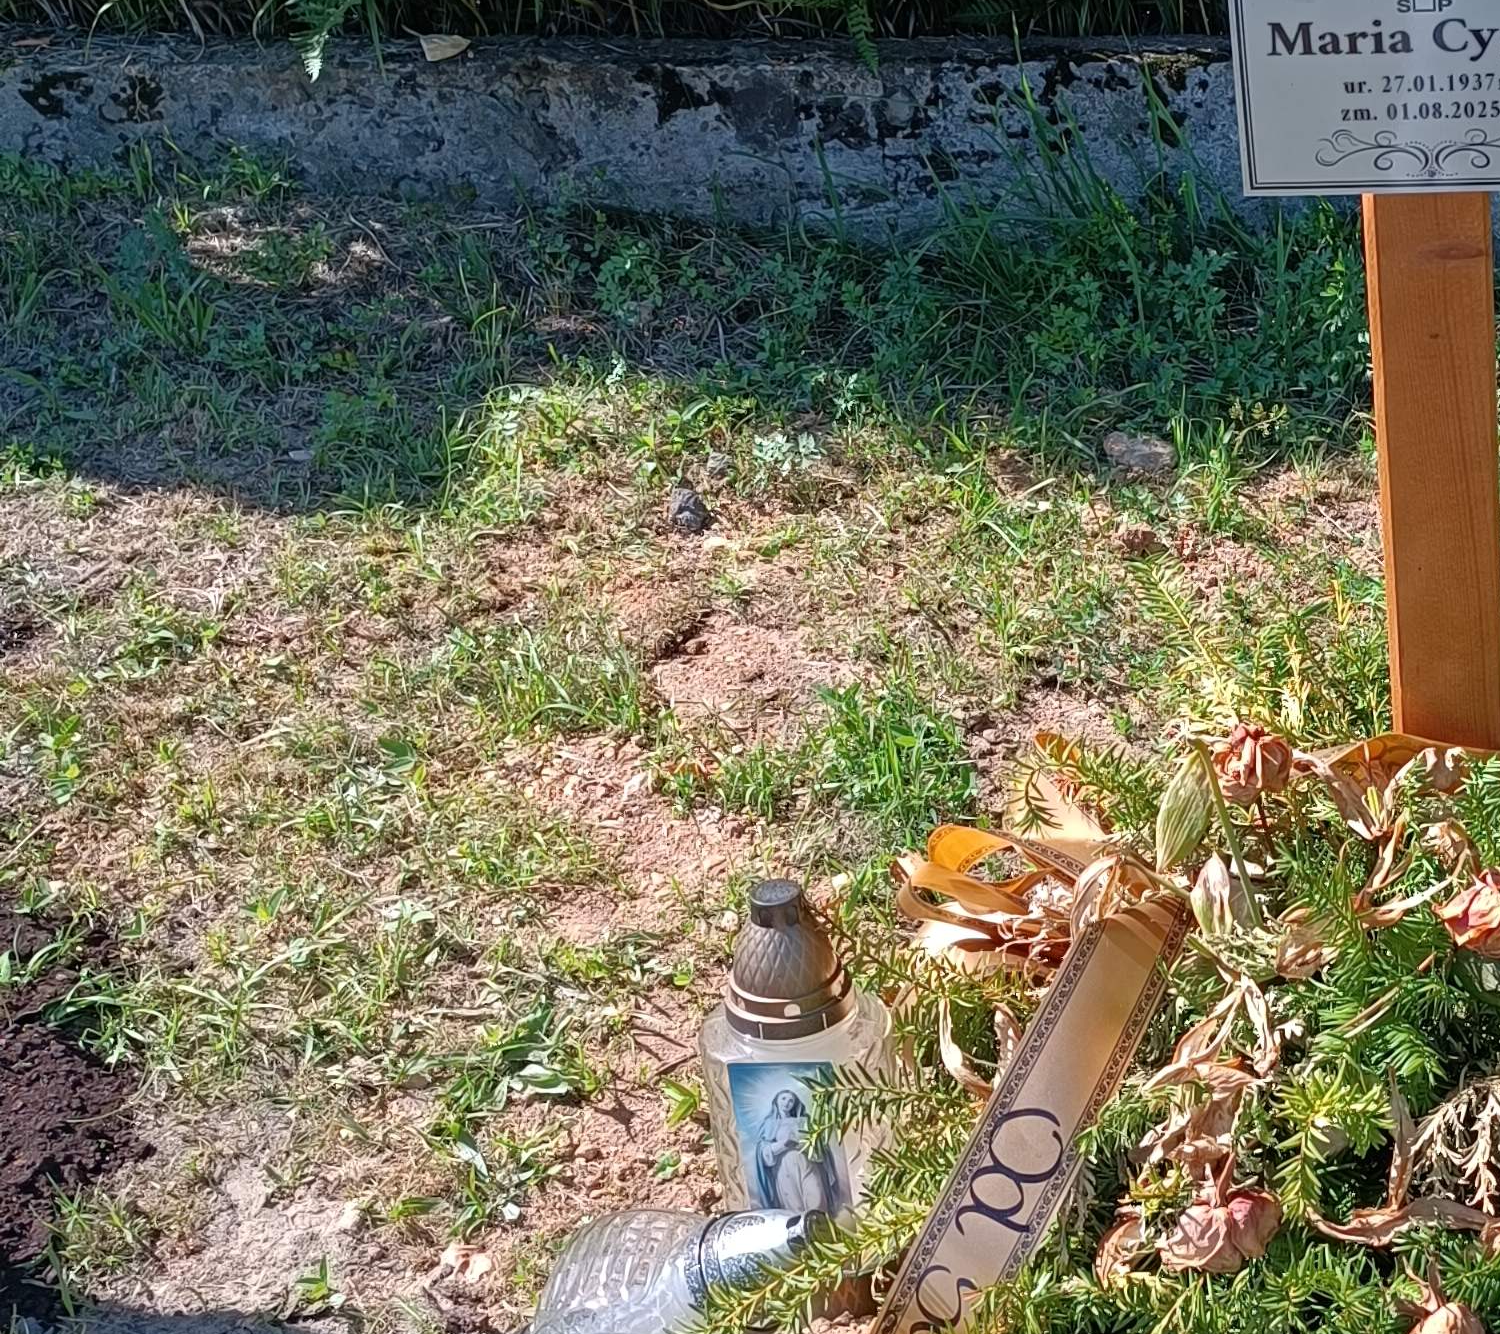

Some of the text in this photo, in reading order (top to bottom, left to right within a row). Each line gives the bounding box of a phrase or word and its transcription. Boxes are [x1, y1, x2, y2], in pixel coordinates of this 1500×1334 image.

[1267, 19, 1414, 56] Maria
[1343, 80, 1373, 94] ur.
[1340, 108, 1378, 122] zm.
[954, 1106, 1065, 1236] Od
